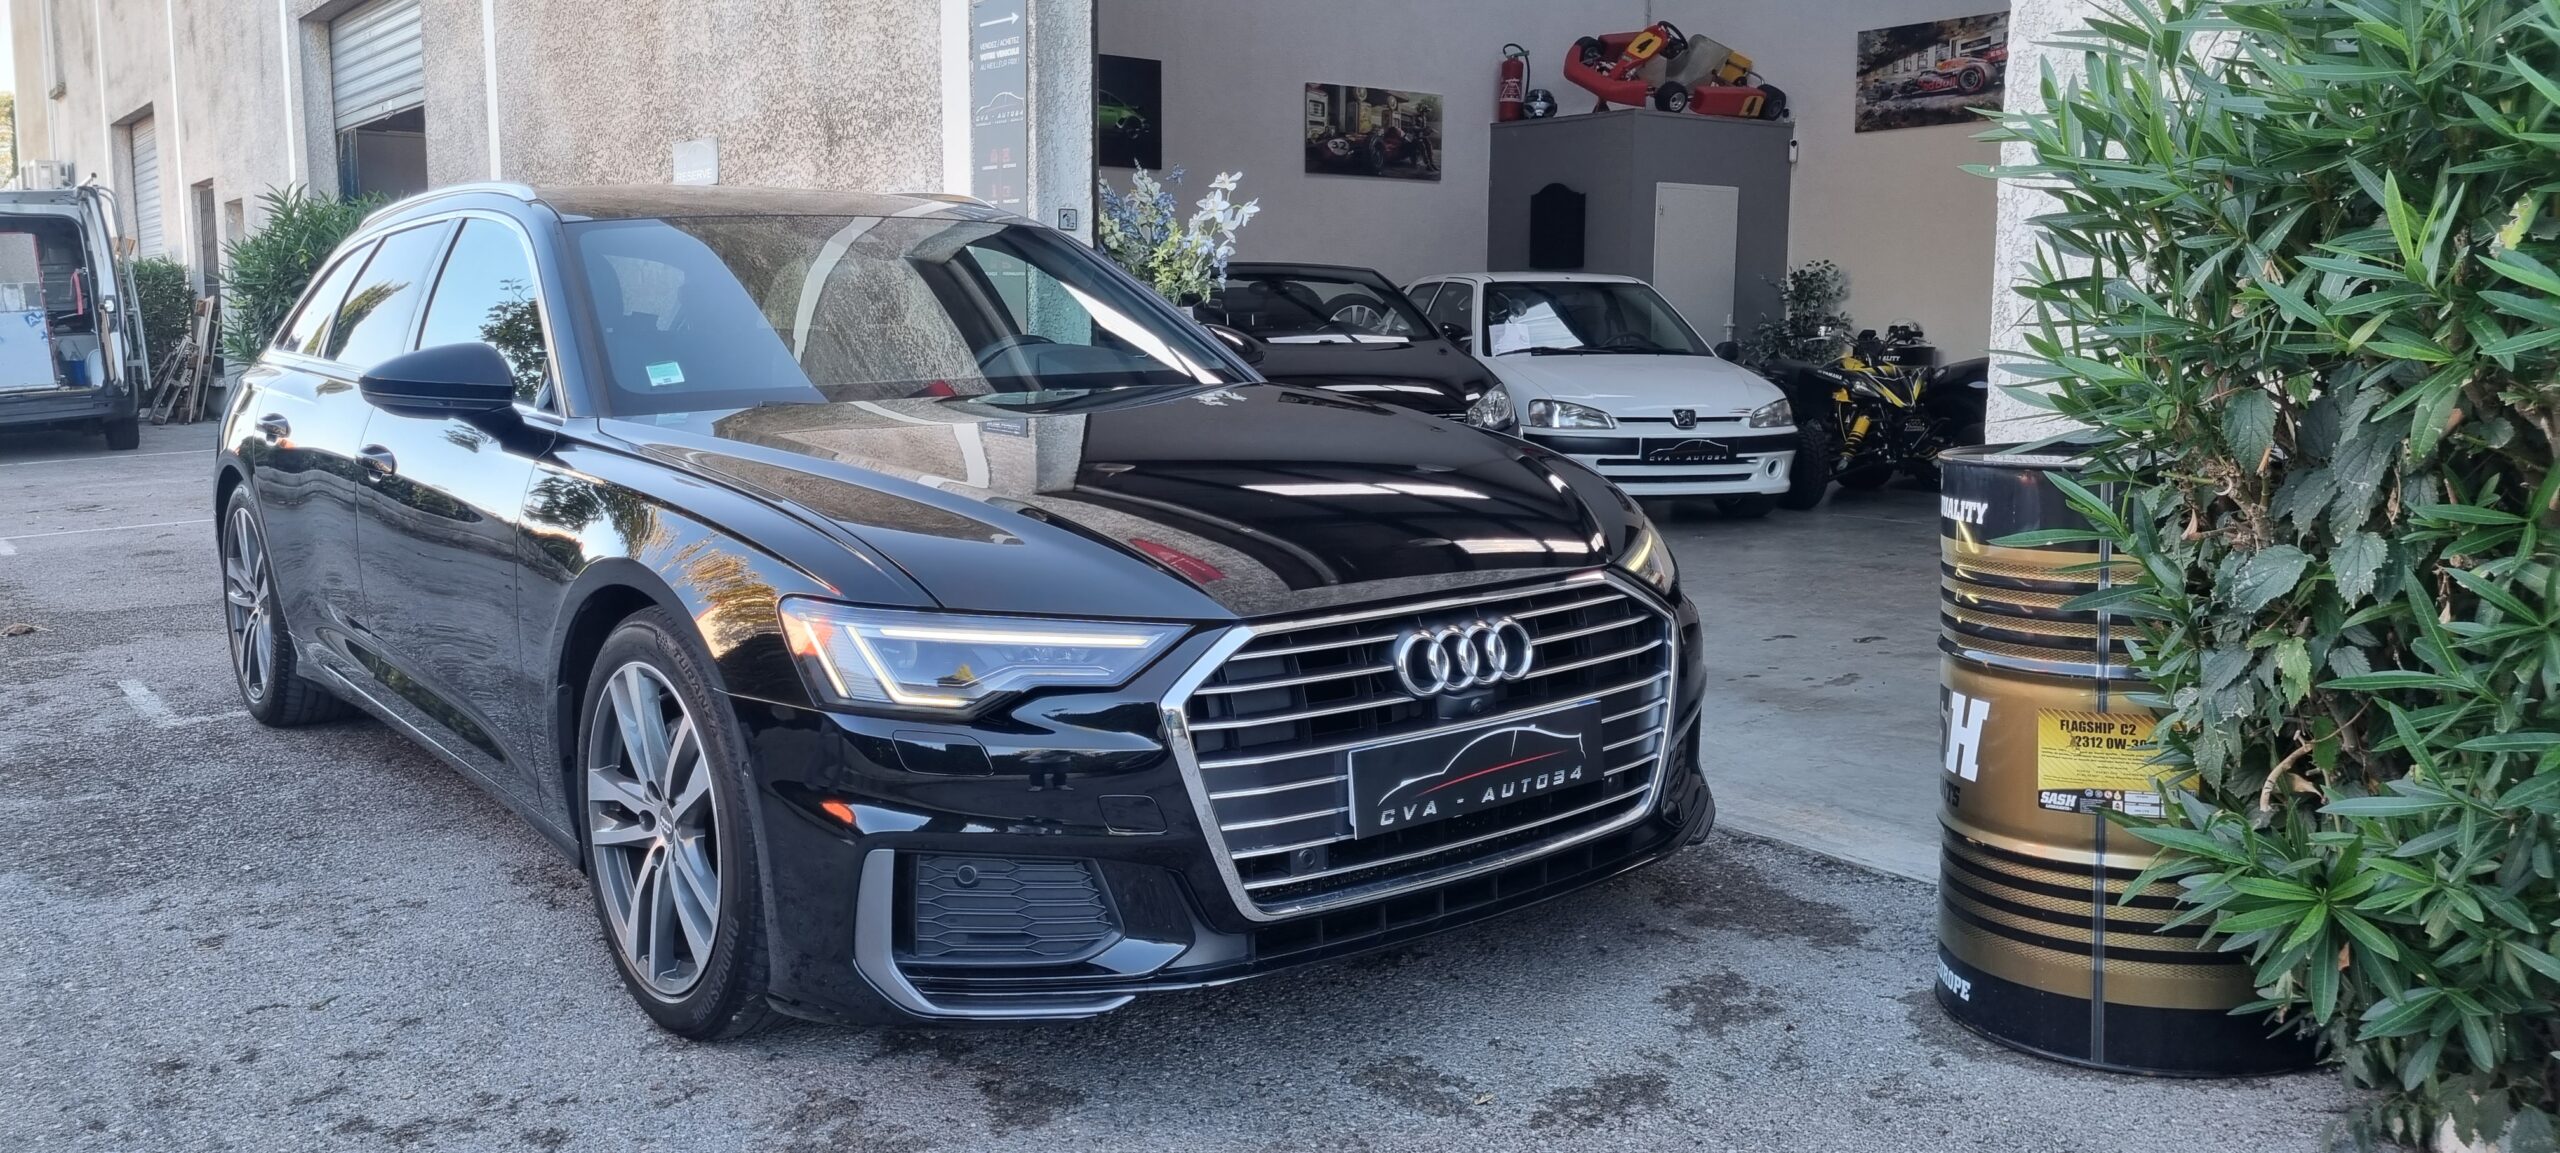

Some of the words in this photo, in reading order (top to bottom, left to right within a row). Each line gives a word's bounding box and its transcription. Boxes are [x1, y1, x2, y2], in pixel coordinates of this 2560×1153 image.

[1331, 140, 1348, 151] 32
[2060, 719, 2115, 734] FLAGSHIP
[2120, 723, 2137, 736] C2
[1380, 800, 1437, 826] CVA
[1481, 765, 1582, 803] AUTO34
[2040, 791, 2077, 807] SASH
